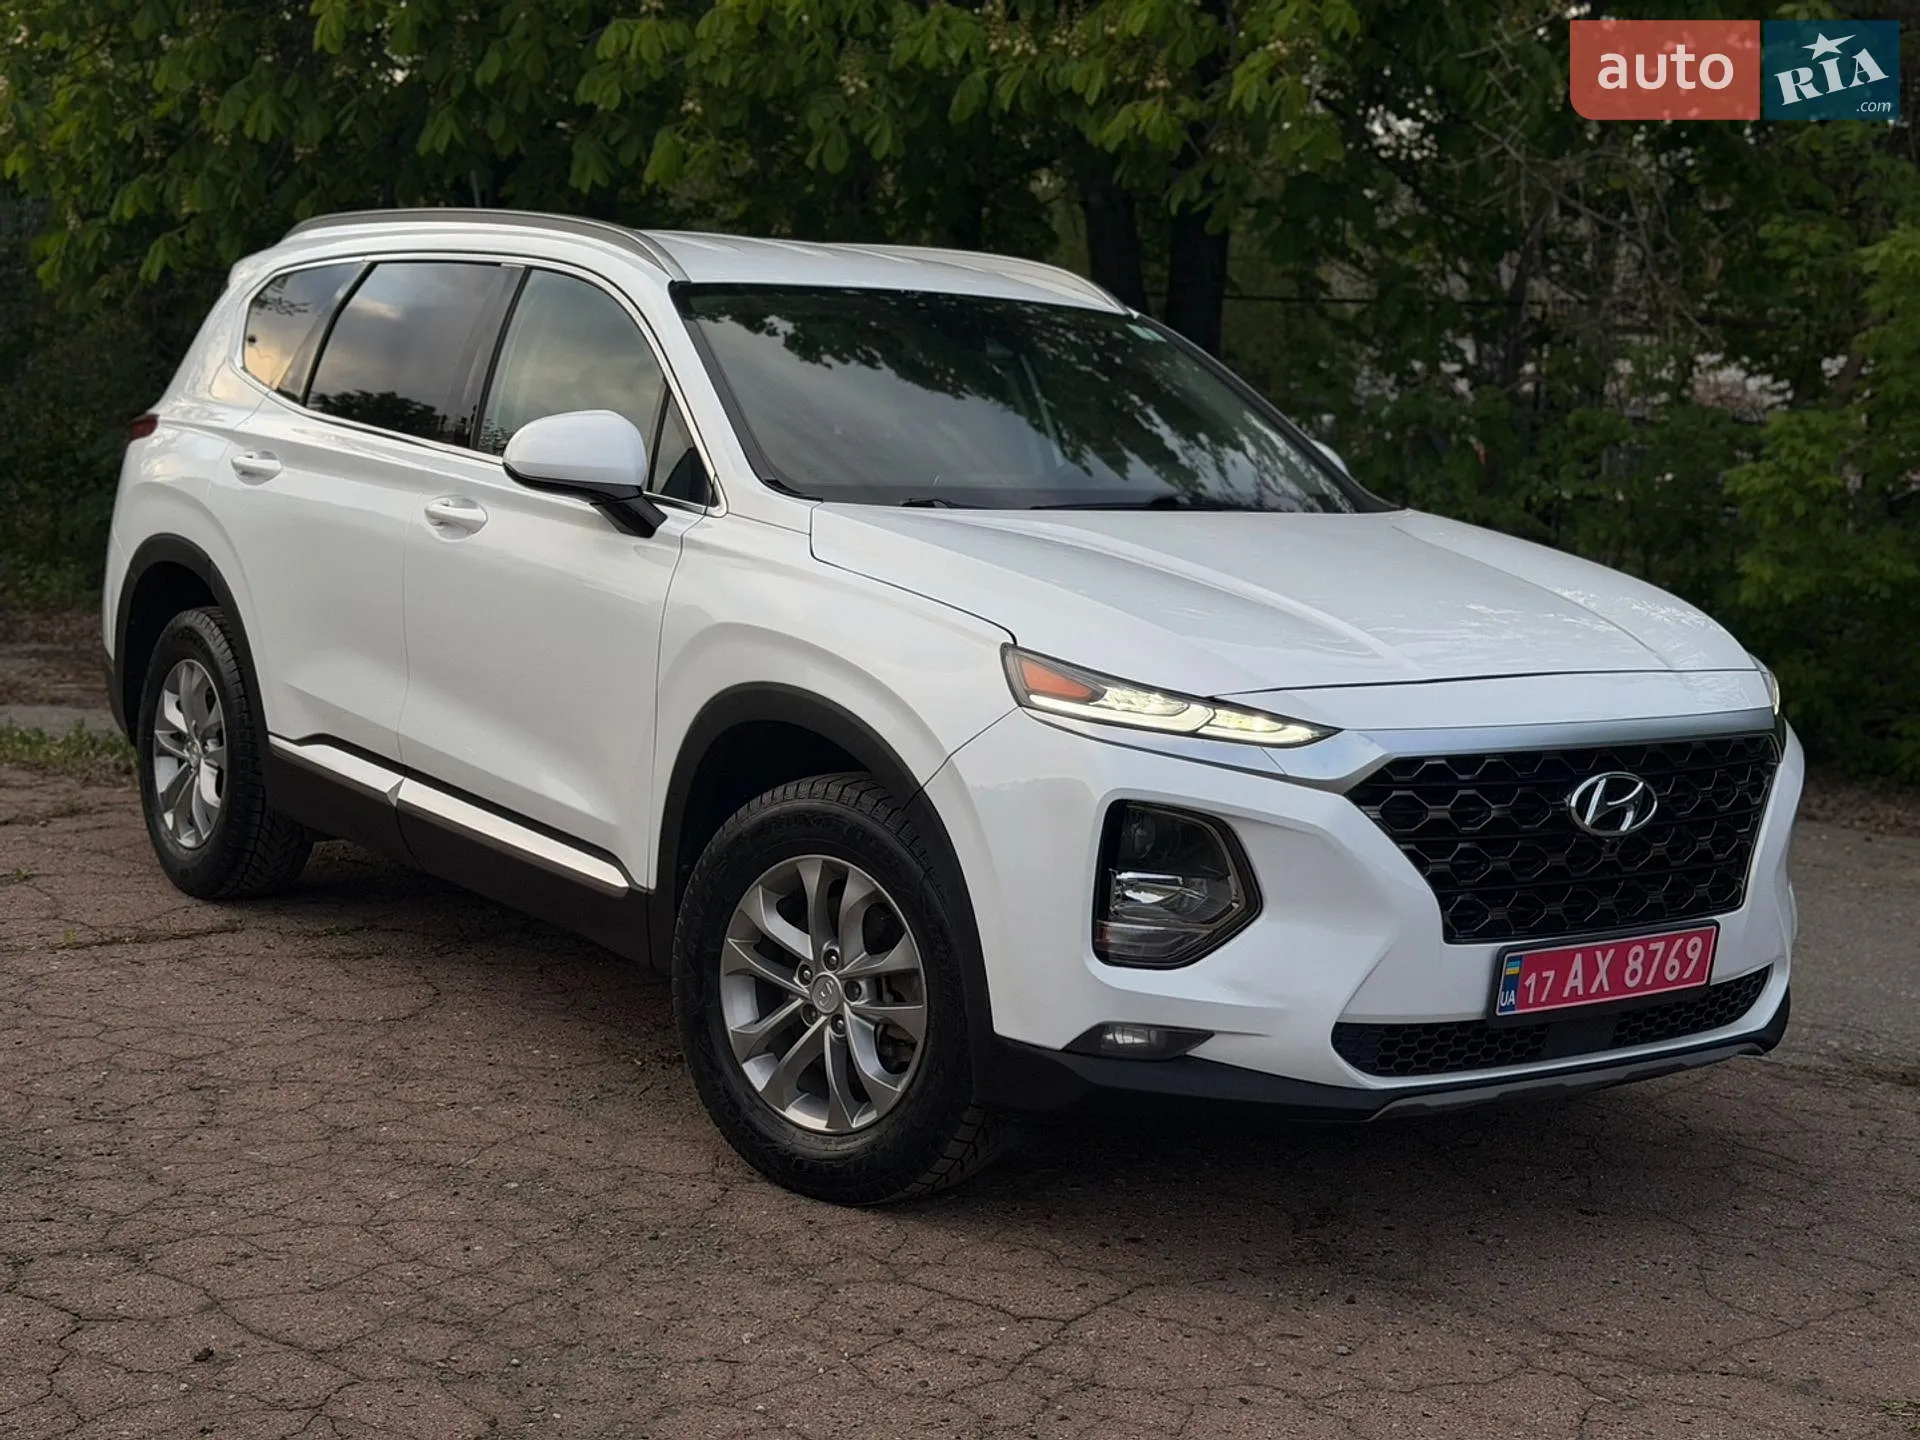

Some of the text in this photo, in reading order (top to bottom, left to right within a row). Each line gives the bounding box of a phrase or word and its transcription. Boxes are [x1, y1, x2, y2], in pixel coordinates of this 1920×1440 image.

[1524, 936, 1703, 1004] 17 AX 8769
[1500, 990, 1516, 1007] UA
